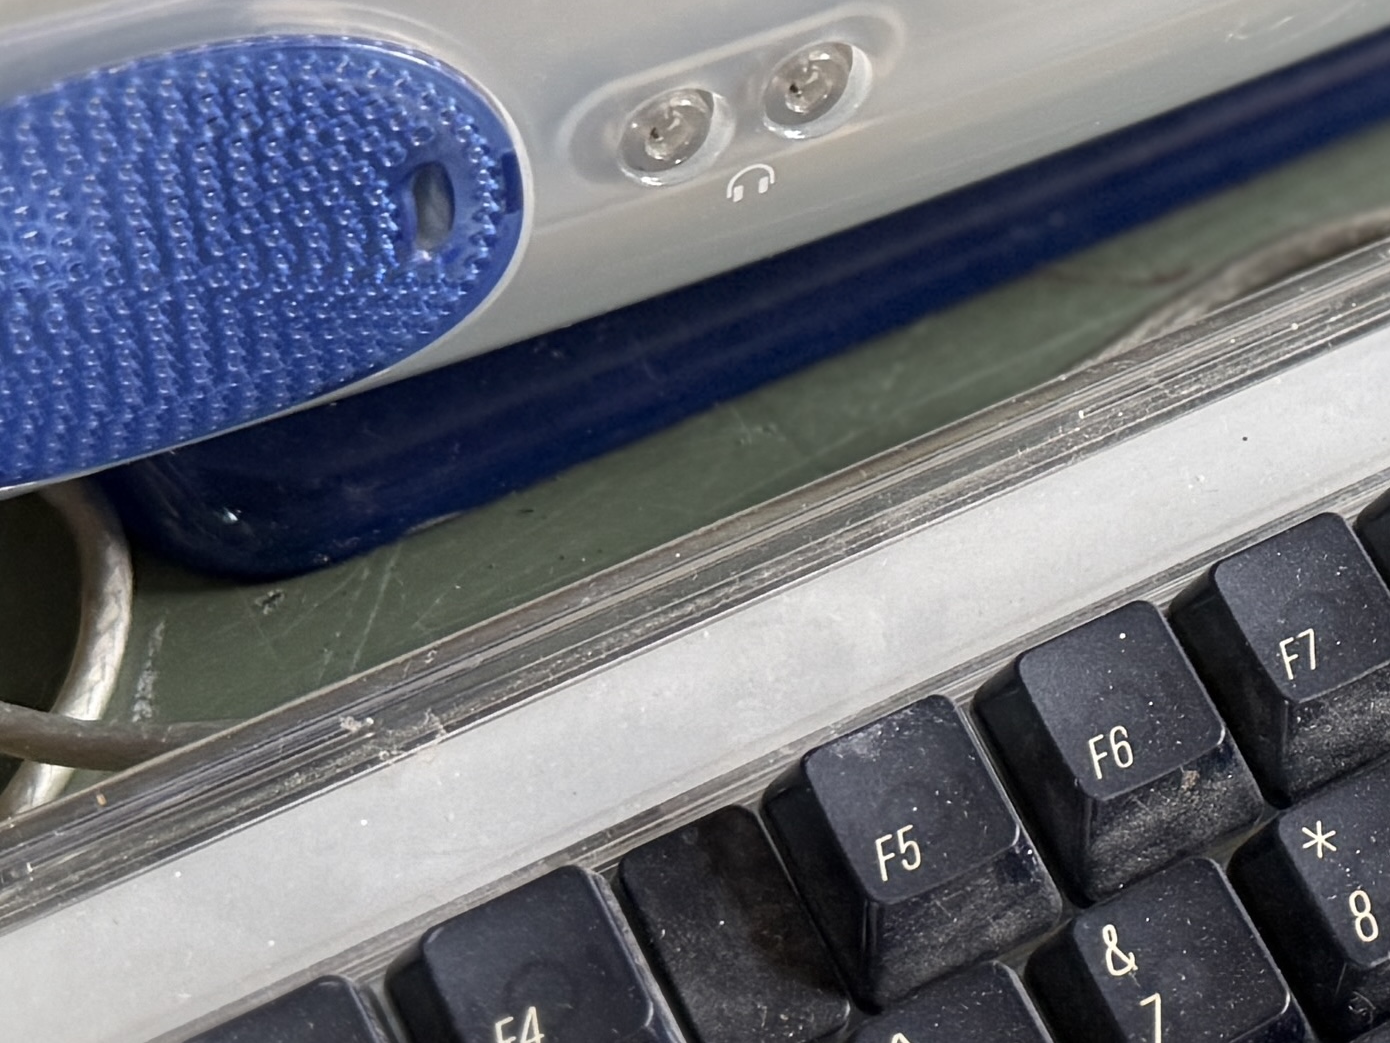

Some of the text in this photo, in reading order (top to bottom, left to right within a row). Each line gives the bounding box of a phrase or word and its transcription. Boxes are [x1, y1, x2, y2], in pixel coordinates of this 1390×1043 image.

[1278, 628, 1316, 680] F7
[1087, 725, 1134, 780] F6
[874, 824, 921, 882] F5
[1348, 889, 1379, 942] 8
[1101, 924, 1139, 977] &
[1139, 992, 1162, 1043] 7
